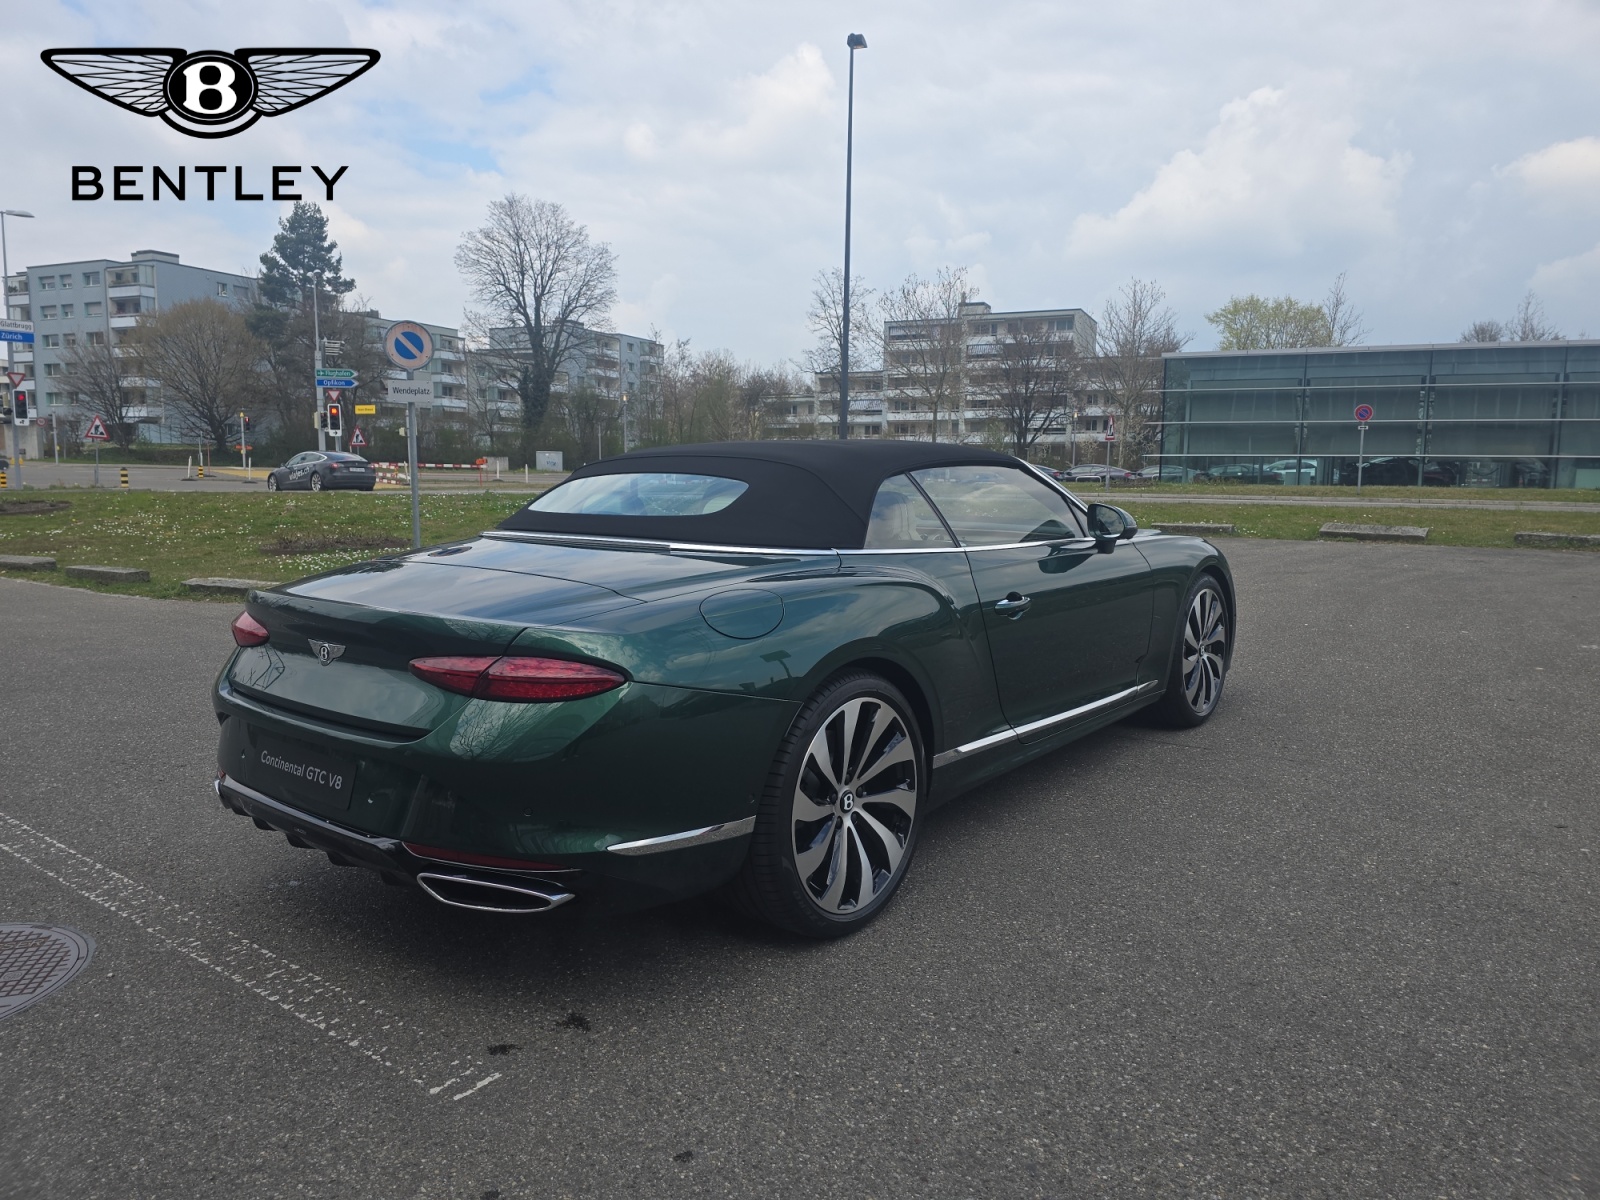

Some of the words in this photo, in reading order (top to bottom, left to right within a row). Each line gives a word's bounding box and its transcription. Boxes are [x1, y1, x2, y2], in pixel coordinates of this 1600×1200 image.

[0, 320, 32, 331] Glattbrugg
[1, 332, 23, 341] Zürich
[325, 369, 351, 377] Flughafen
[392, 386, 430, 397] Wendeplatz
[260, 750, 306, 777] Continental
[306, 766, 327, 785] GTC
[329, 773, 343, 789] V8
[843, 793, 854, 811] B
